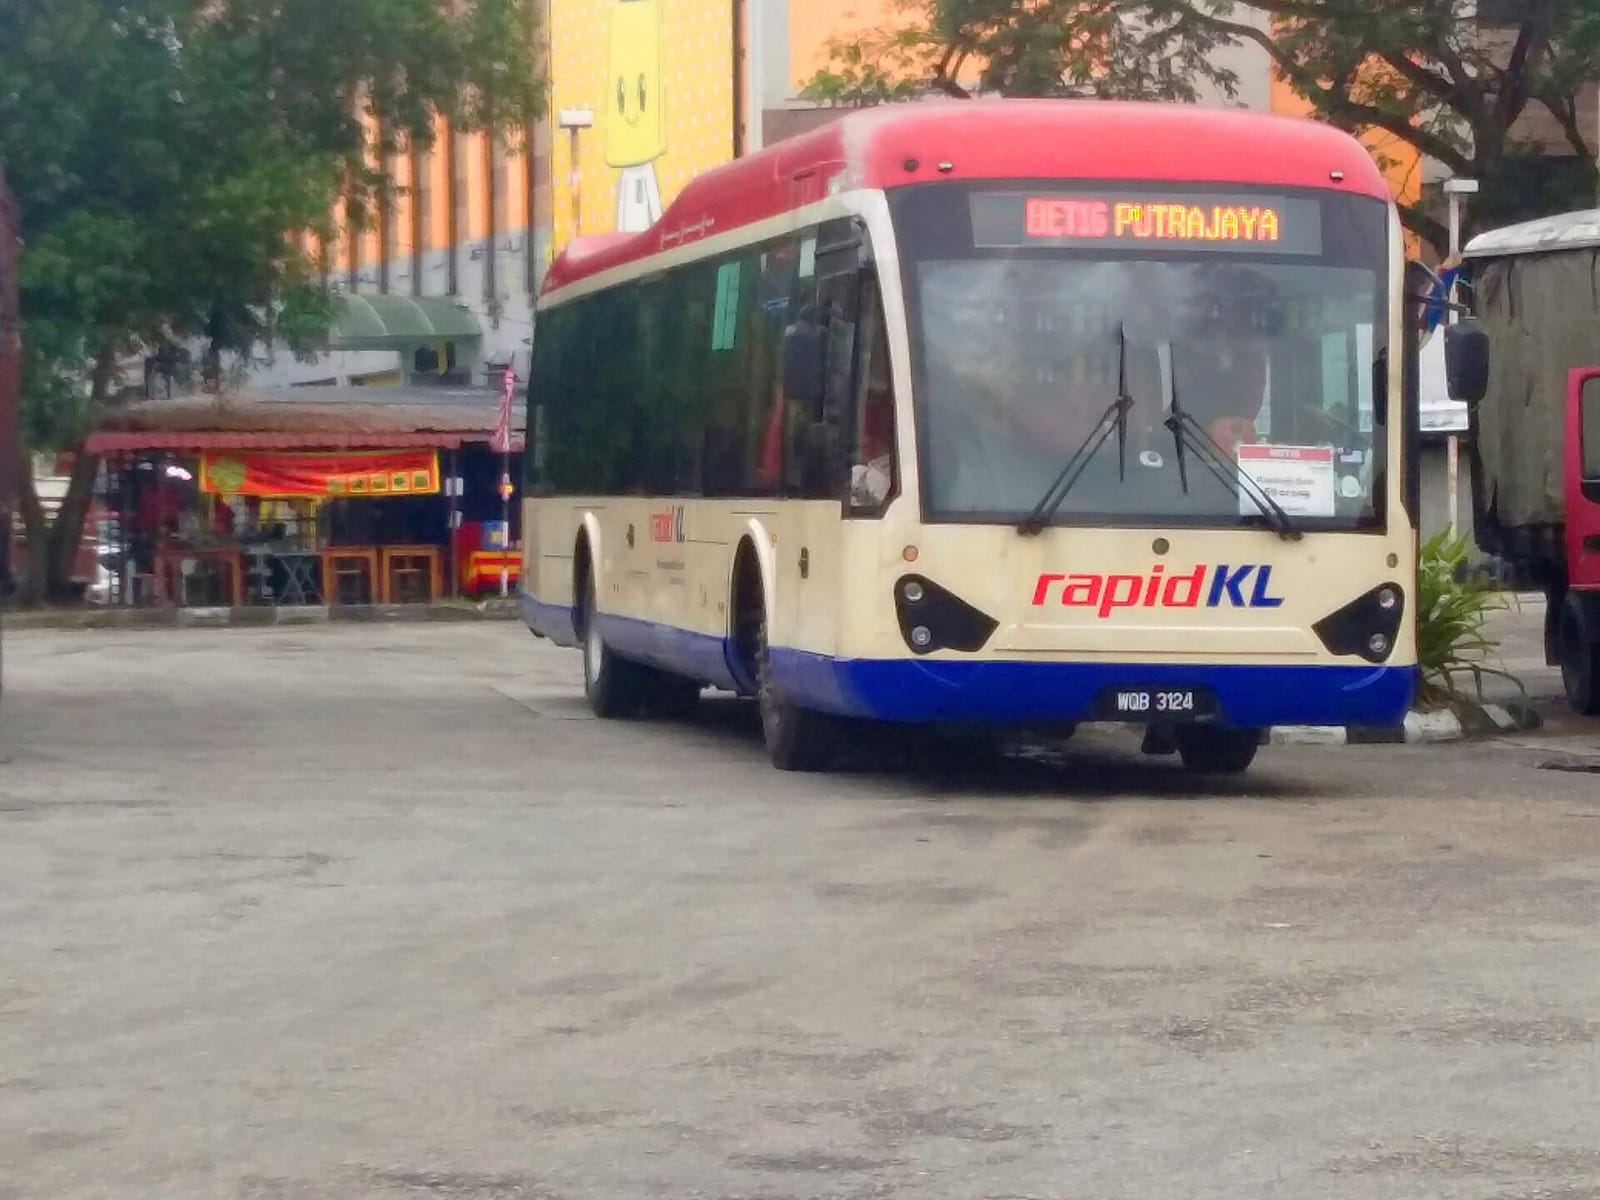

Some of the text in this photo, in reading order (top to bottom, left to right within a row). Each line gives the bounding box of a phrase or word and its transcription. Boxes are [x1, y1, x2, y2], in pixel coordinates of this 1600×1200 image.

[1114, 202, 1279, 241] PUTRAJAYA
[1032, 564, 1285, 618] rapidKL
[1117, 691, 1194, 711] WQB 3124
